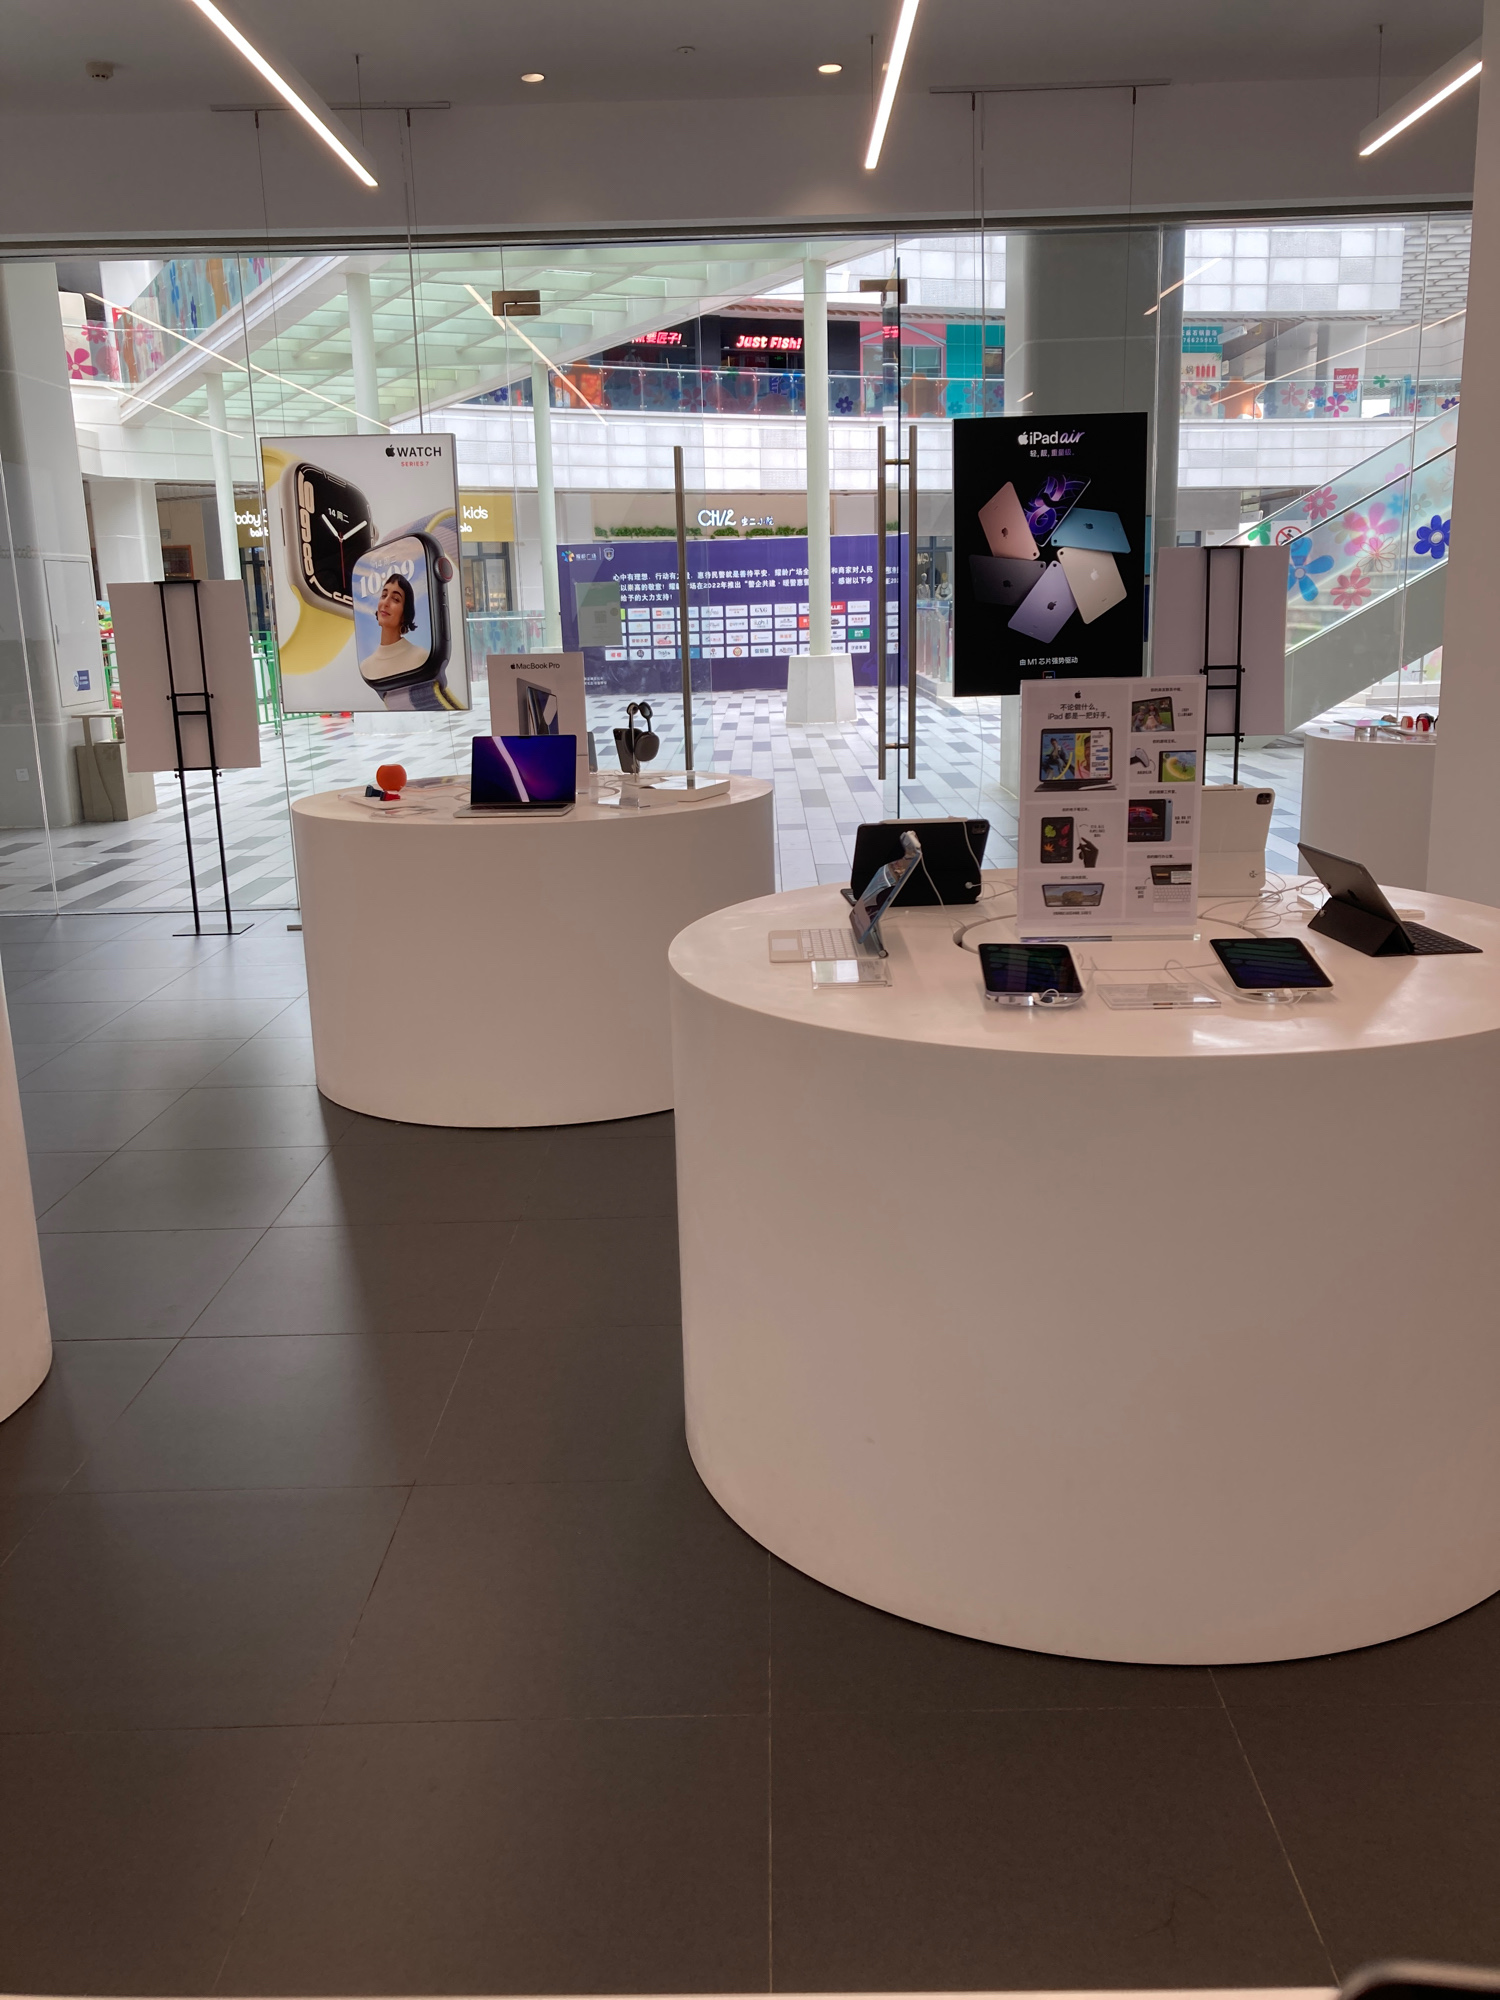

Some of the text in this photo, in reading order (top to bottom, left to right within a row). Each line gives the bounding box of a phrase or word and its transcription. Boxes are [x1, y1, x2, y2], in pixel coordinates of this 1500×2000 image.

[736, 335, 803, 349] Just Fish!
[1029, 429, 1086, 445] iPad air
[396, 446, 442, 457] WATCH
[328, 507, 336, 517] 14
[462, 505, 489, 519] kids
[234, 510, 261, 528] baby
[1038, 656, 1078, 665] 芯片强势驱动
[1047, 712, 1064, 720] iPad
